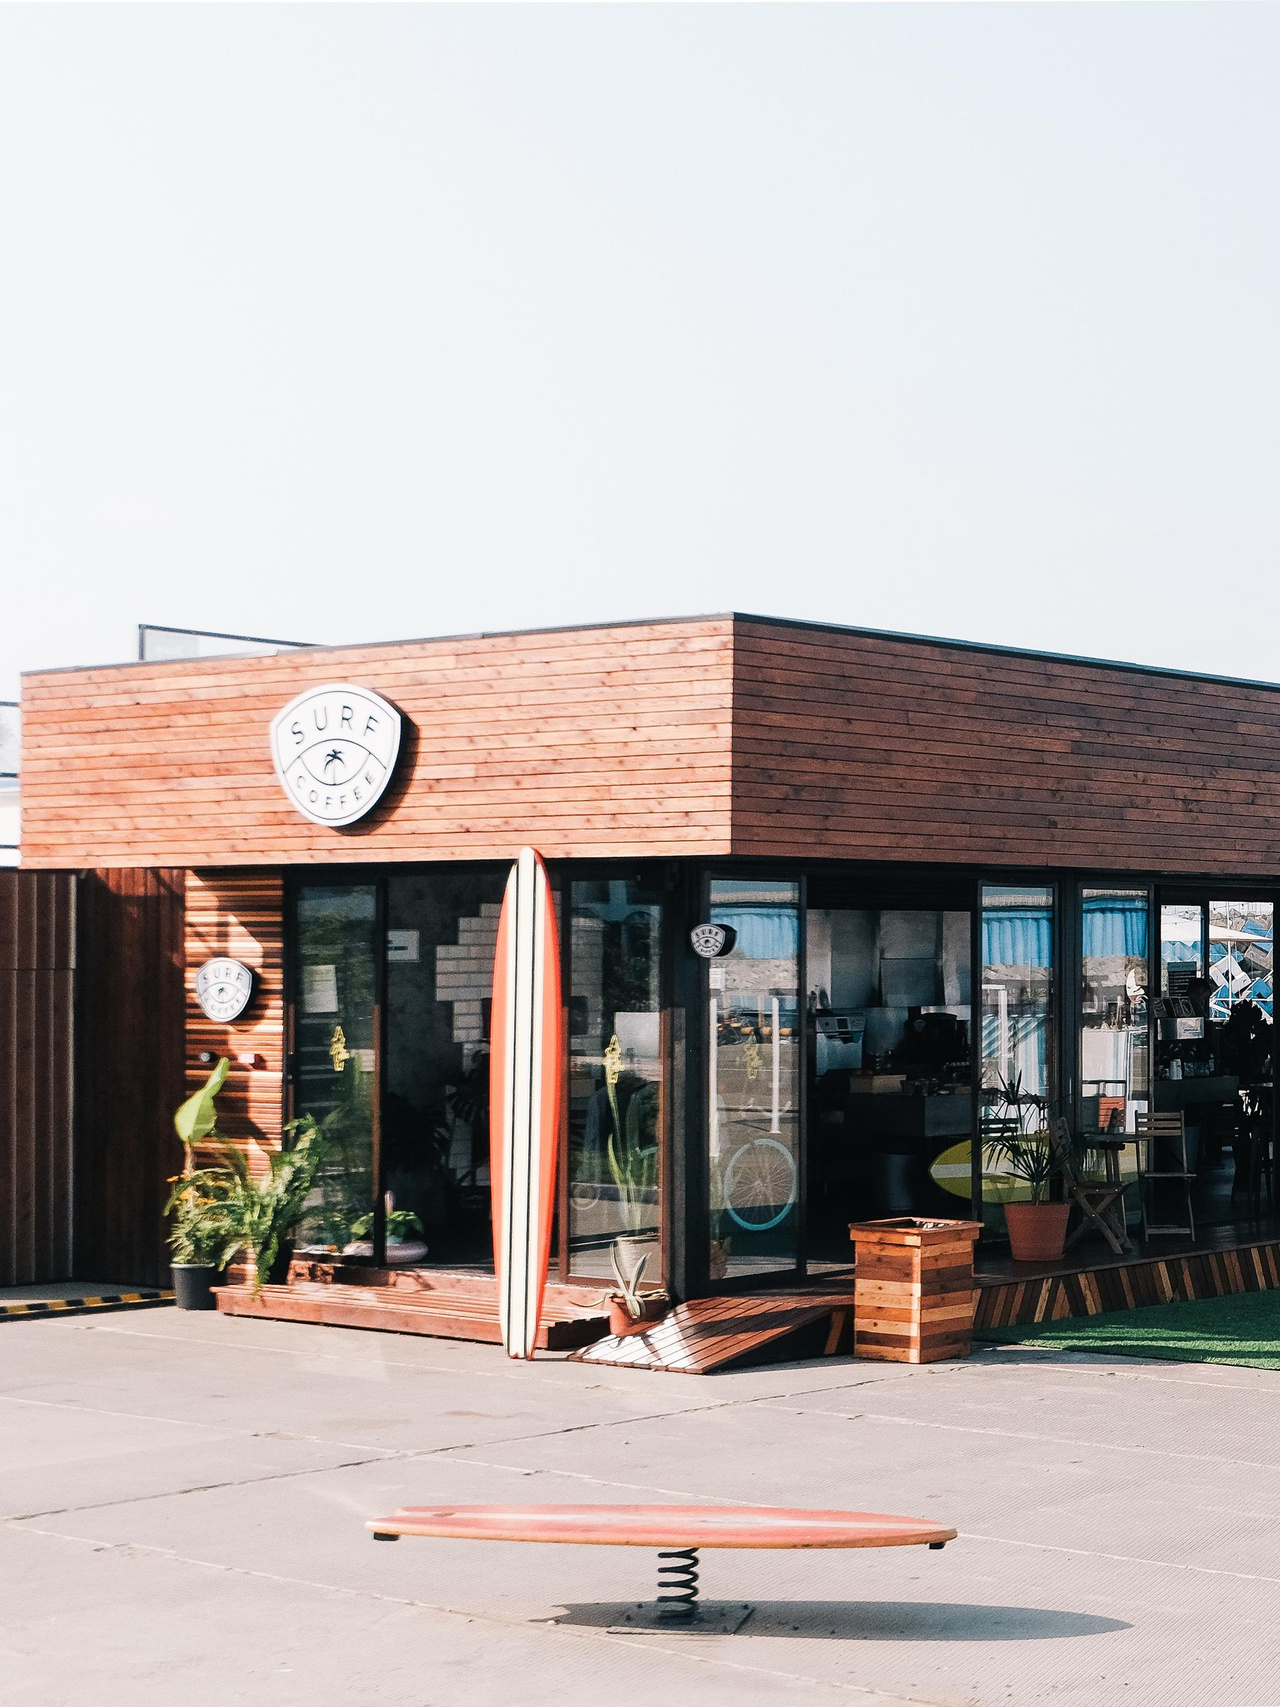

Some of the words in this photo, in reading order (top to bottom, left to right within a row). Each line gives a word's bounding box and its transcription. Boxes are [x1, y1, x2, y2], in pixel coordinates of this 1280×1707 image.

[290, 705, 380, 745] SURF
[296, 771, 376, 811] COFFEE
[203, 967, 244, 984] SURF
